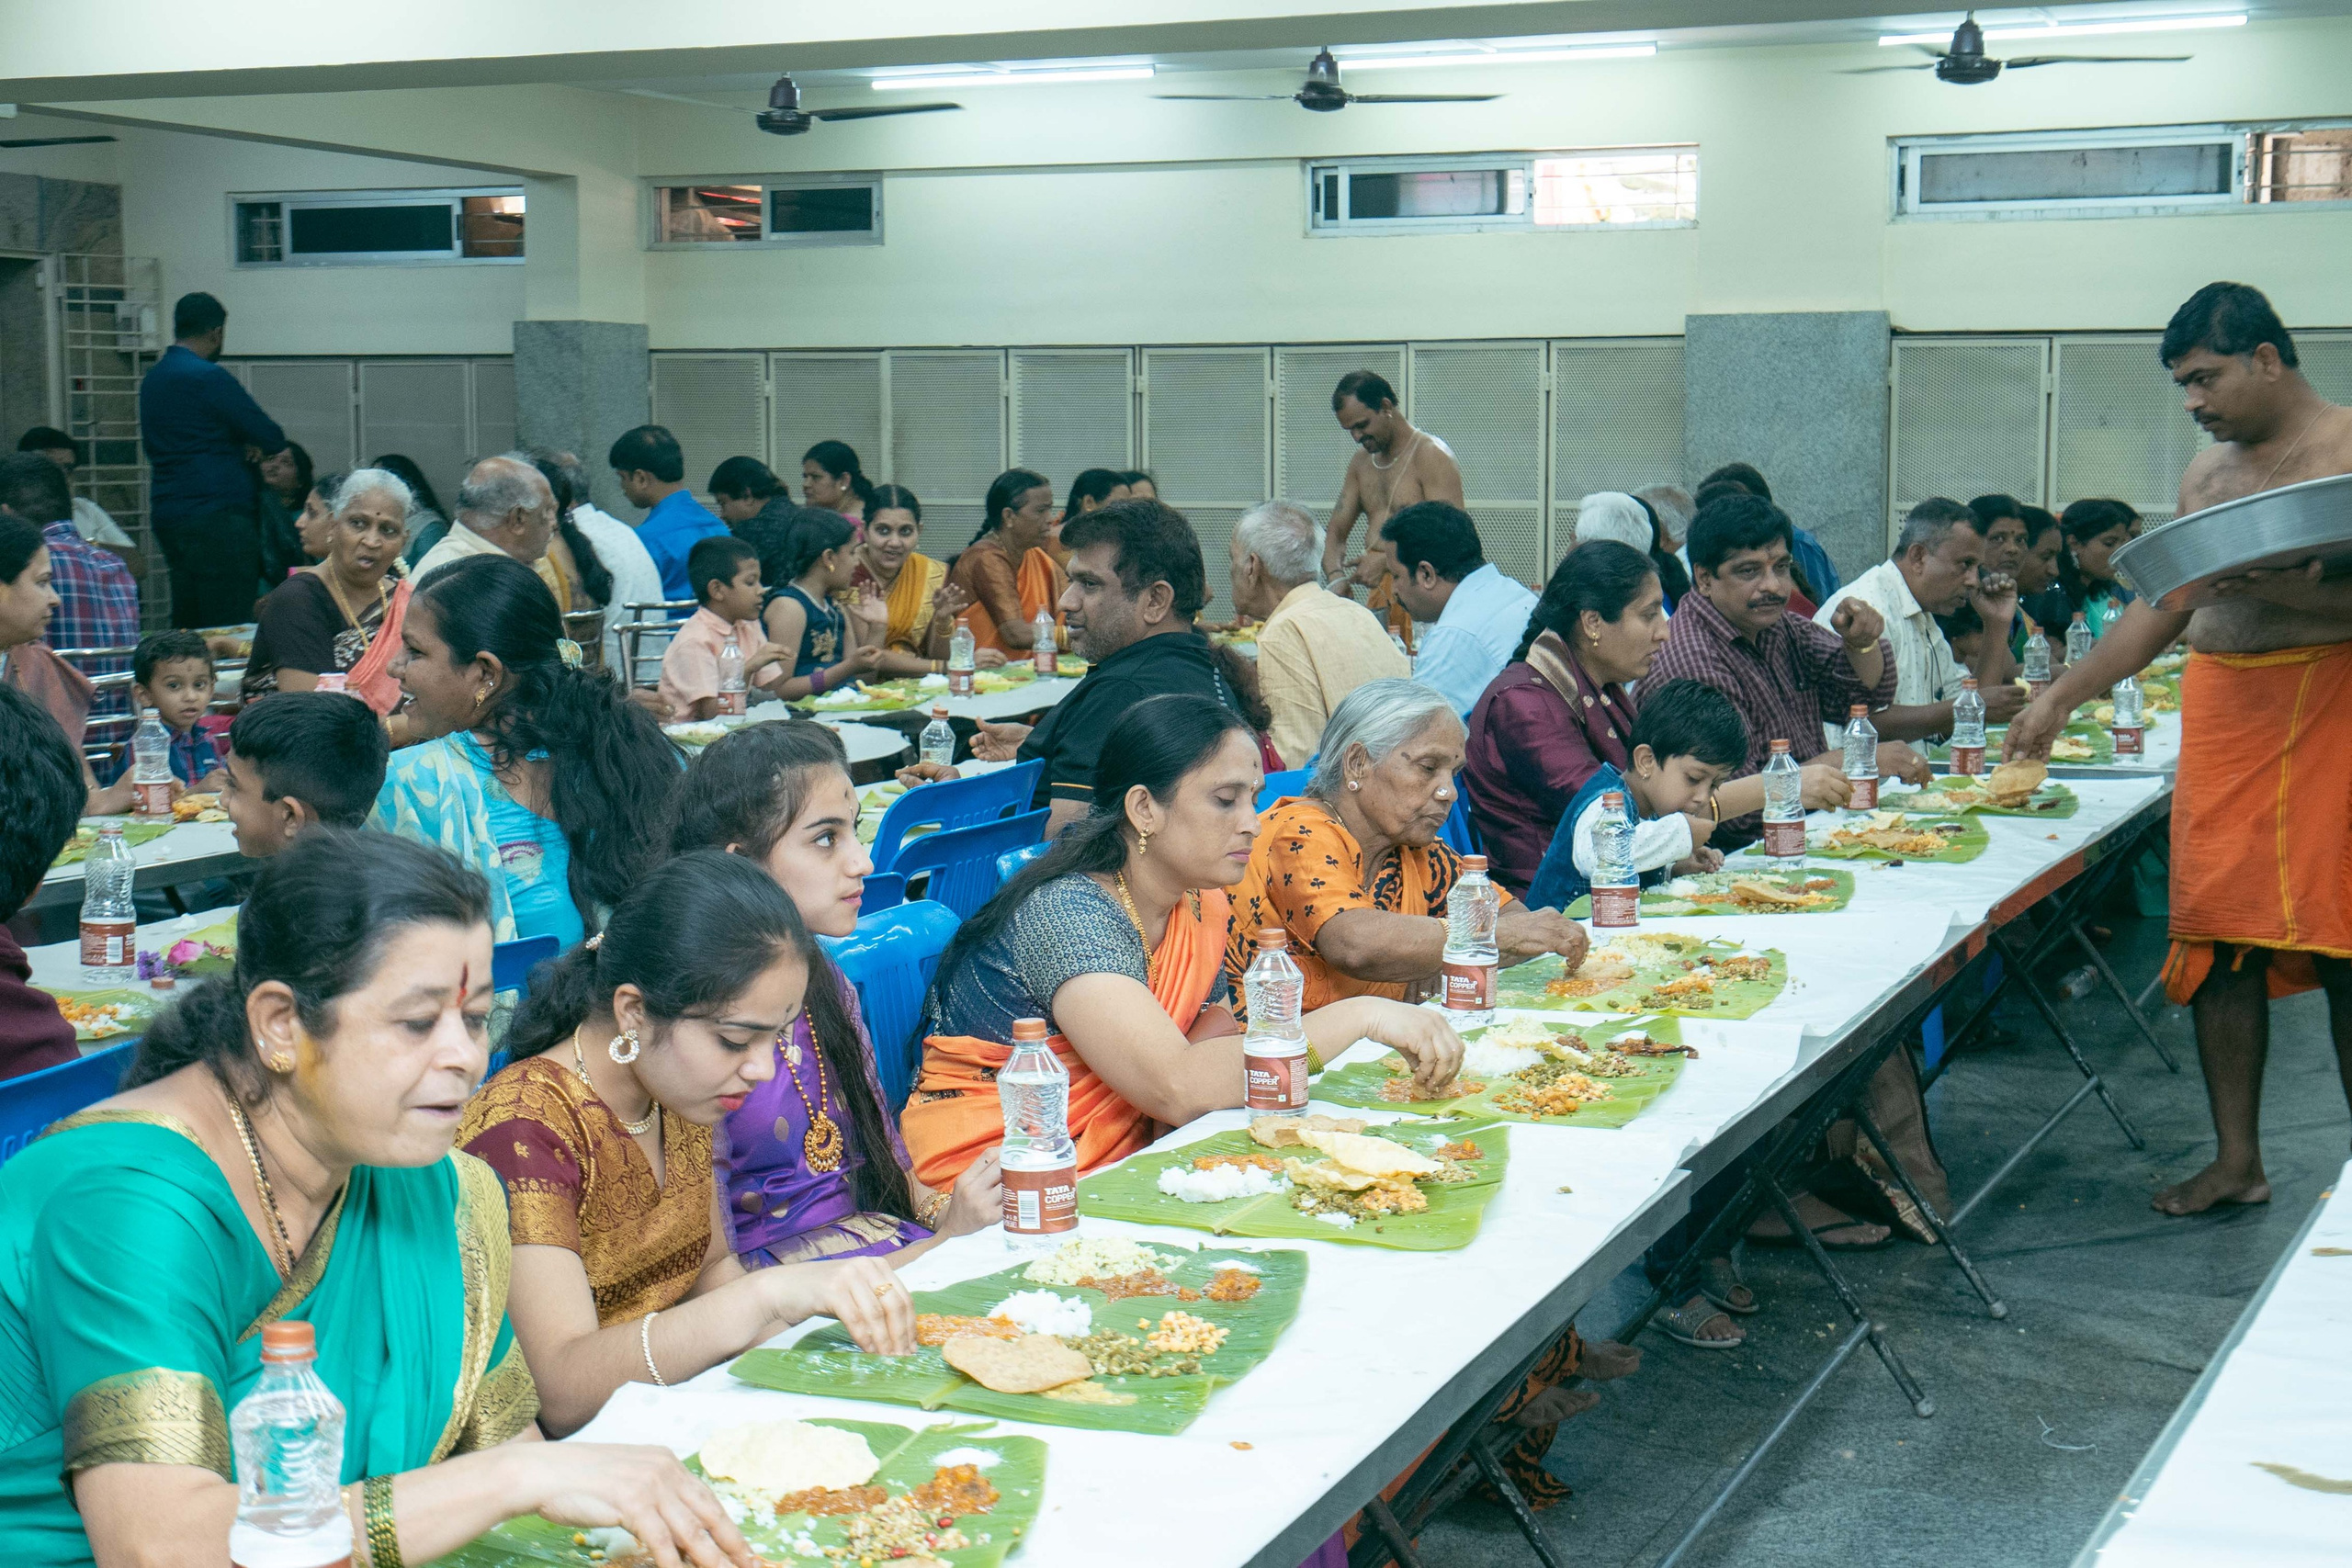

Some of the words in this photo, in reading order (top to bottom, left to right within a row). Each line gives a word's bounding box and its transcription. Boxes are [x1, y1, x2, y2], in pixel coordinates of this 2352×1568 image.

[1250, 1077, 1278, 1085] COPPER
[1044, 1185, 1069, 1195] TATA
[1045, 1190, 1075, 1204] COPPER
